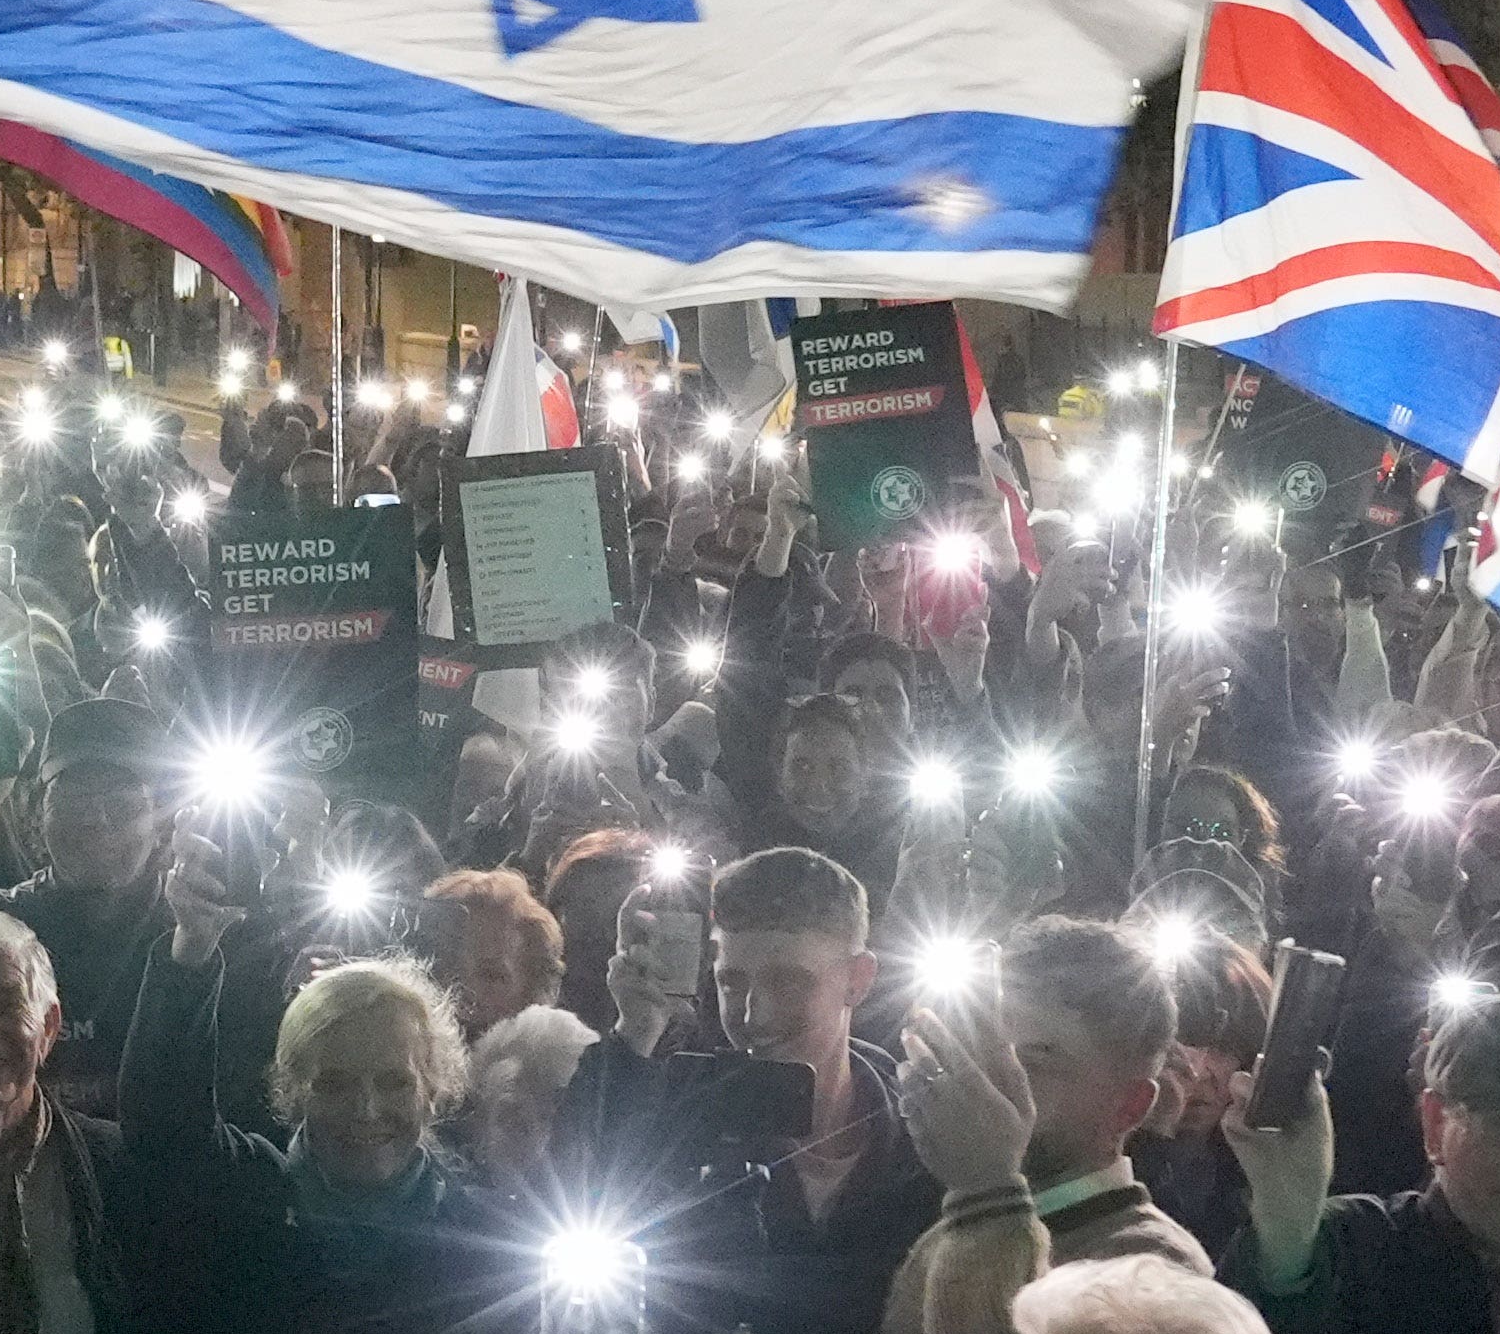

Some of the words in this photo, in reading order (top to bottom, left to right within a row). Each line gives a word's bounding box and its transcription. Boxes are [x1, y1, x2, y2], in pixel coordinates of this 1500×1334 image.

[801, 330, 894, 355] REWARD
[804, 347, 925, 375] TERRORISM
[808, 377, 849, 396] GET
[811, 391, 933, 421] TERRORISM
[221, 538, 335, 563] REWARD
[222, 560, 370, 588] TERRORISM
[224, 593, 274, 614] GET
[225, 617, 373, 645] TERRORISM
